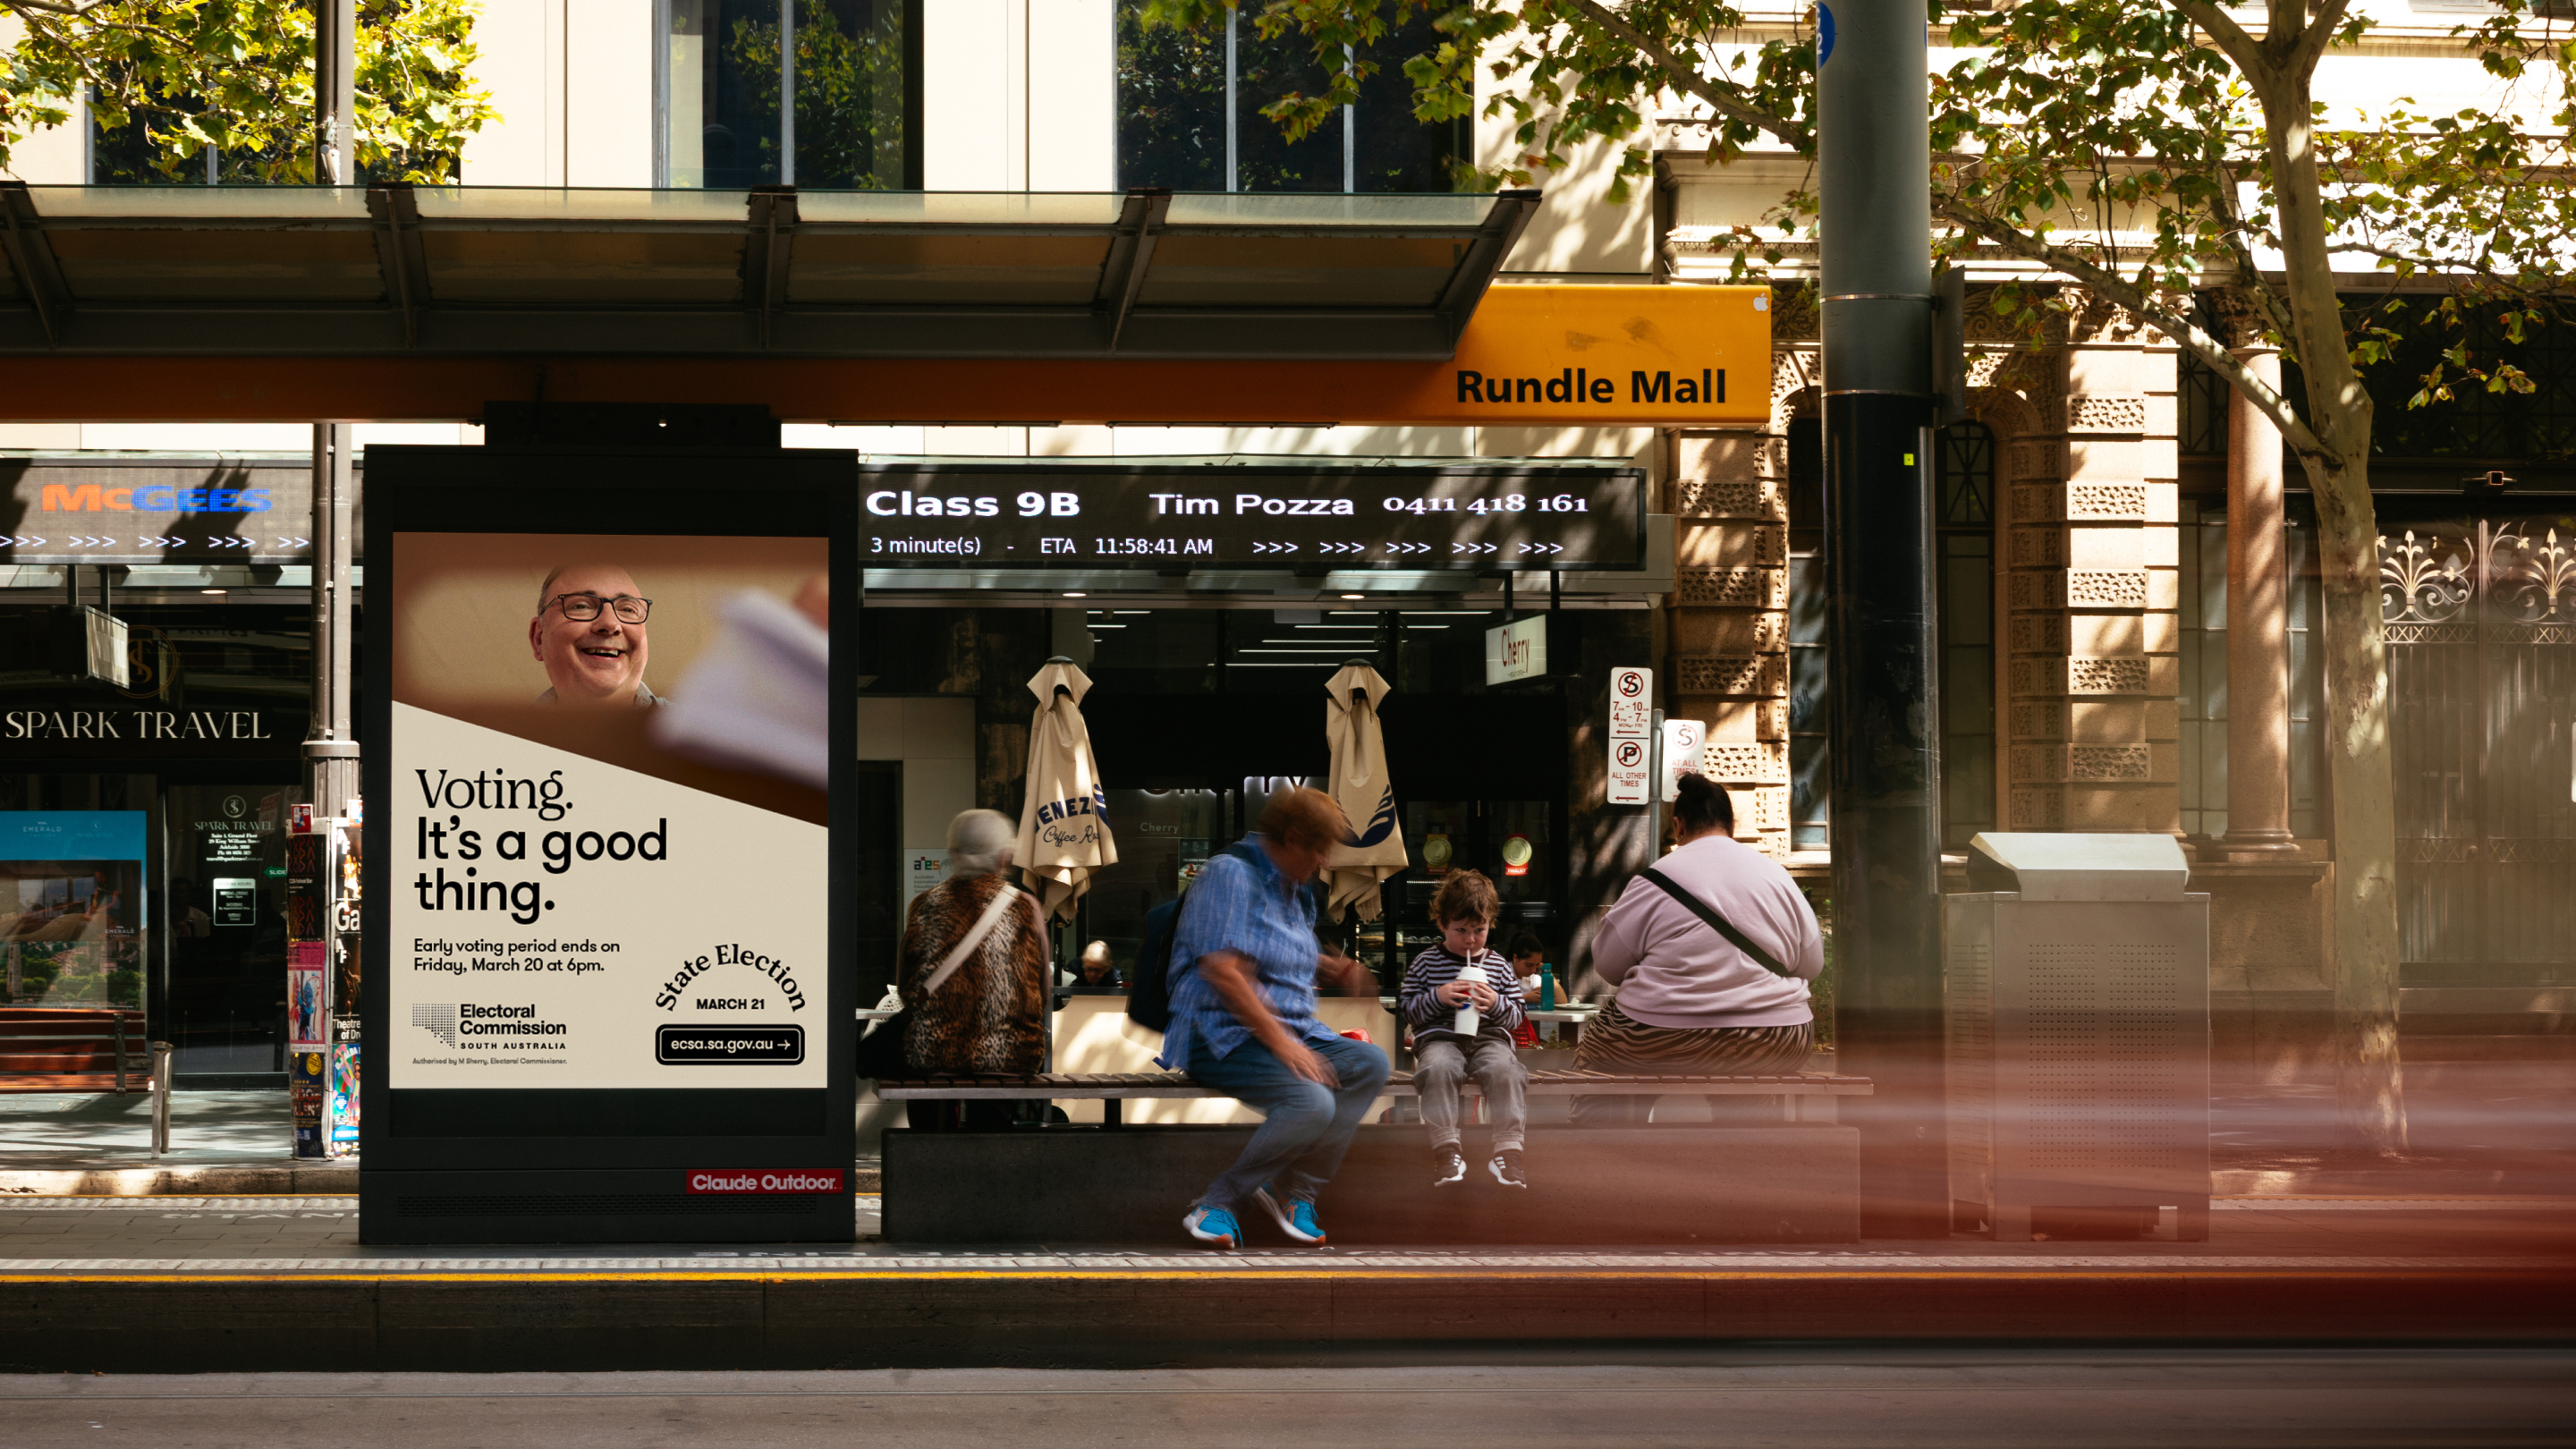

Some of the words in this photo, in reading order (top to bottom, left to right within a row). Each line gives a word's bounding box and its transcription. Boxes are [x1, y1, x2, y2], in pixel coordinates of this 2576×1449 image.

[1457, 368, 1614, 403] Rundle
[1631, 369, 1725, 403] Mall
[866, 491, 999, 517] Class
[1017, 492, 1080, 517] 9B
[1149, 494, 1219, 515] Tim
[1235, 494, 1354, 515] Pozza
[1383, 496, 1457, 515] 0411
[1467, 494, 1526, 515] 418
[1538, 494, 1589, 513] 161
[870, 538, 882, 554] 3
[889, 537, 981, 555] minute(s)
[1040, 538, 1077, 555] ETA
[1096, 538, 1178, 555] 11:58:41
[1183, 538, 1213, 555] AM
[1501, 628, 1530, 674] Cherry
[5, 711, 121, 739] SPARK
[133, 711, 271, 739] TRAVEL
[415, 767, 573, 821] Voting.
[194, 821, 230, 830] SPARK
[233, 821, 275, 830] TRAVEL
[1140, 822, 1179, 834] Cherry
[418, 815, 482, 860] It’s
[496, 830, 526, 860] a
[542, 818, 667, 874] good
[1043, 825, 1077, 847] Coffee
[414, 866, 555, 925] thing.
[414, 938, 453, 956] Early
[456, 938, 504, 956] voting
[508, 938, 556, 956] period
[561, 938, 597, 953] ends
[601, 943, 620, 953] on
[414, 957, 467, 974] Friday,
[471, 957, 520, 971] March
[524, 958, 544, 971] 20
[547, 959, 563, 971] at
[567, 958, 605, 974] 6pm.
[656, 955, 711, 1012] State
[715, 944, 806, 1013] Election
[461, 1004, 535, 1018] Electoral
[696, 998, 748, 1010] MARCH
[751, 998, 765, 1010] 21
[332, 1018, 360, 1029] Theatre
[460, 1021, 566, 1035] Commission
[341, 1030, 350, 1039] of
[671, 1039, 773, 1054] ecsa.sa.gov.au
[448, 1058, 457, 1066] by
[692, 1174, 758, 1191] Claude
